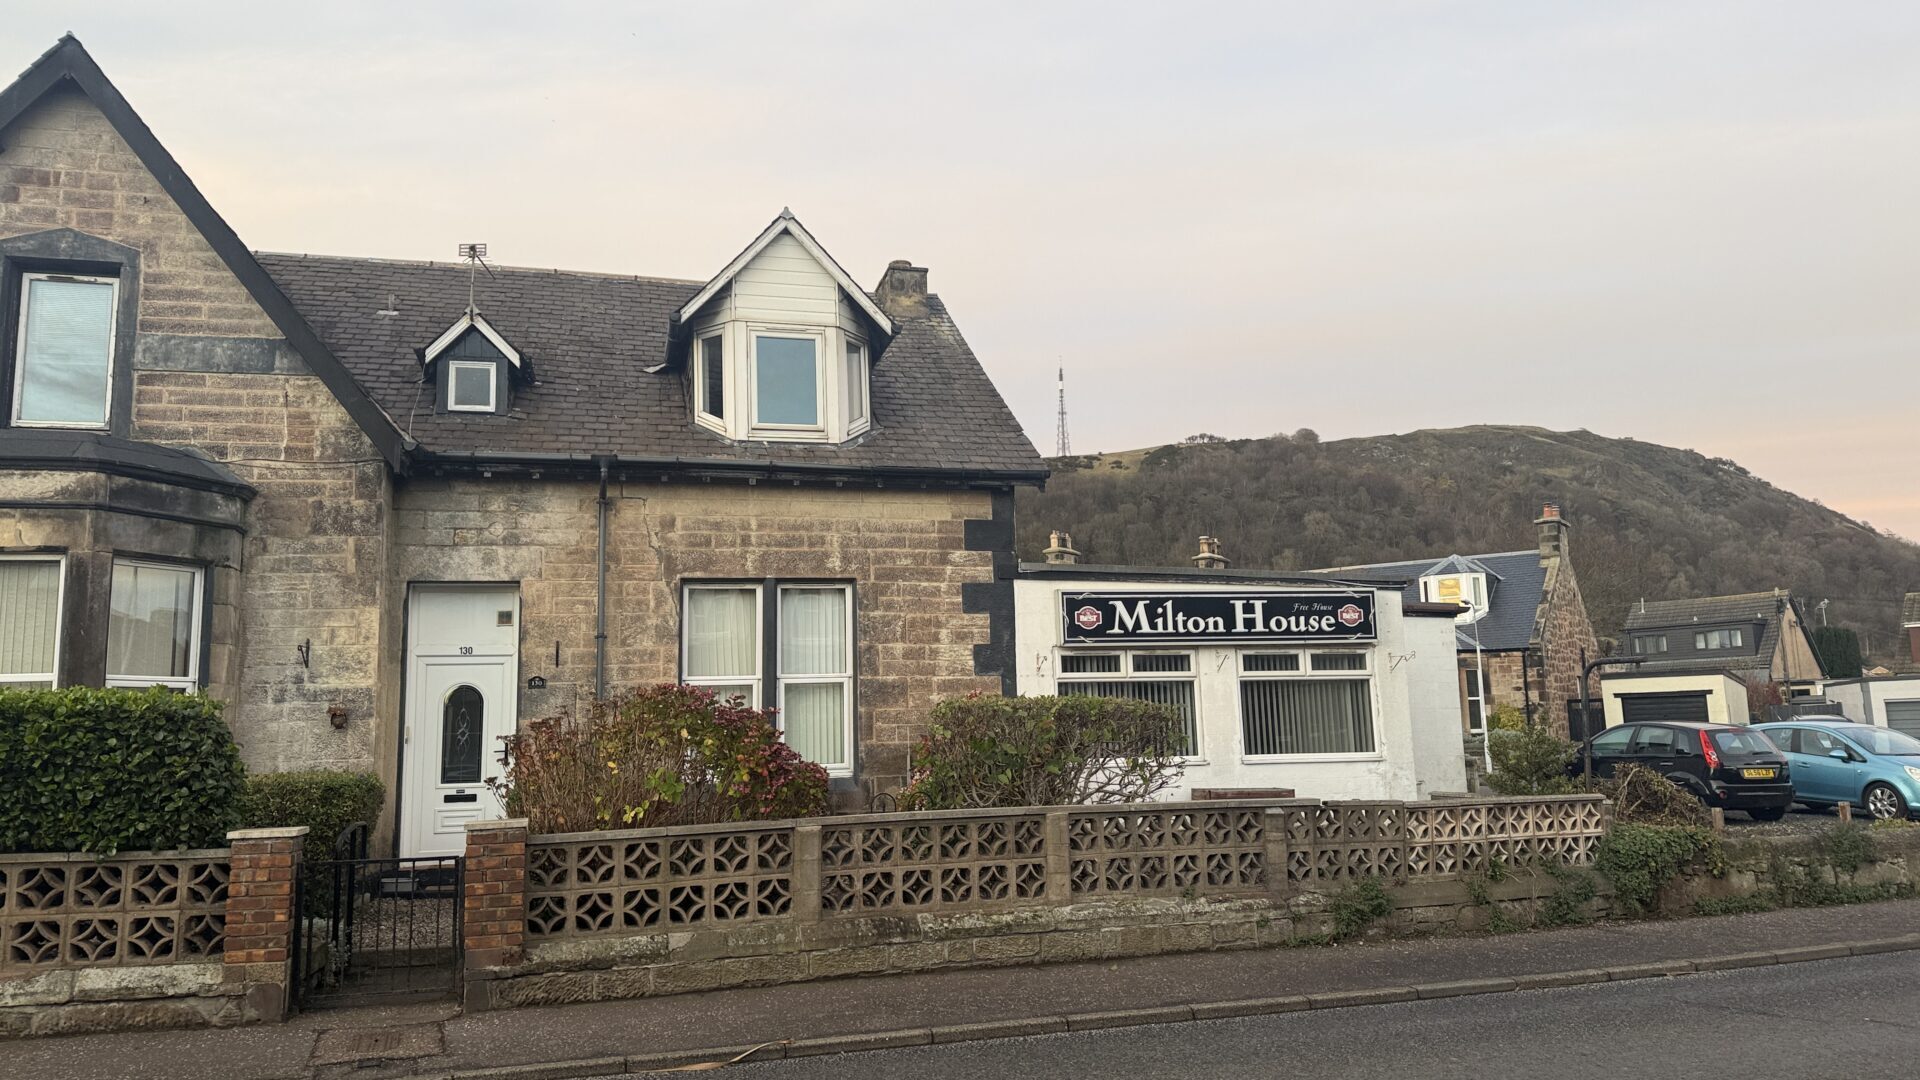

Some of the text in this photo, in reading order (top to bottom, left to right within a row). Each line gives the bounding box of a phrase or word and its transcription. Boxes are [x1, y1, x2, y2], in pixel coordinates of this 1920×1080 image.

[1292, 602, 1309, 613] Free
[1311, 602, 1333, 611] House
[1106, 600, 1336, 633] Milton House
[459, 646, 473, 655] 130
